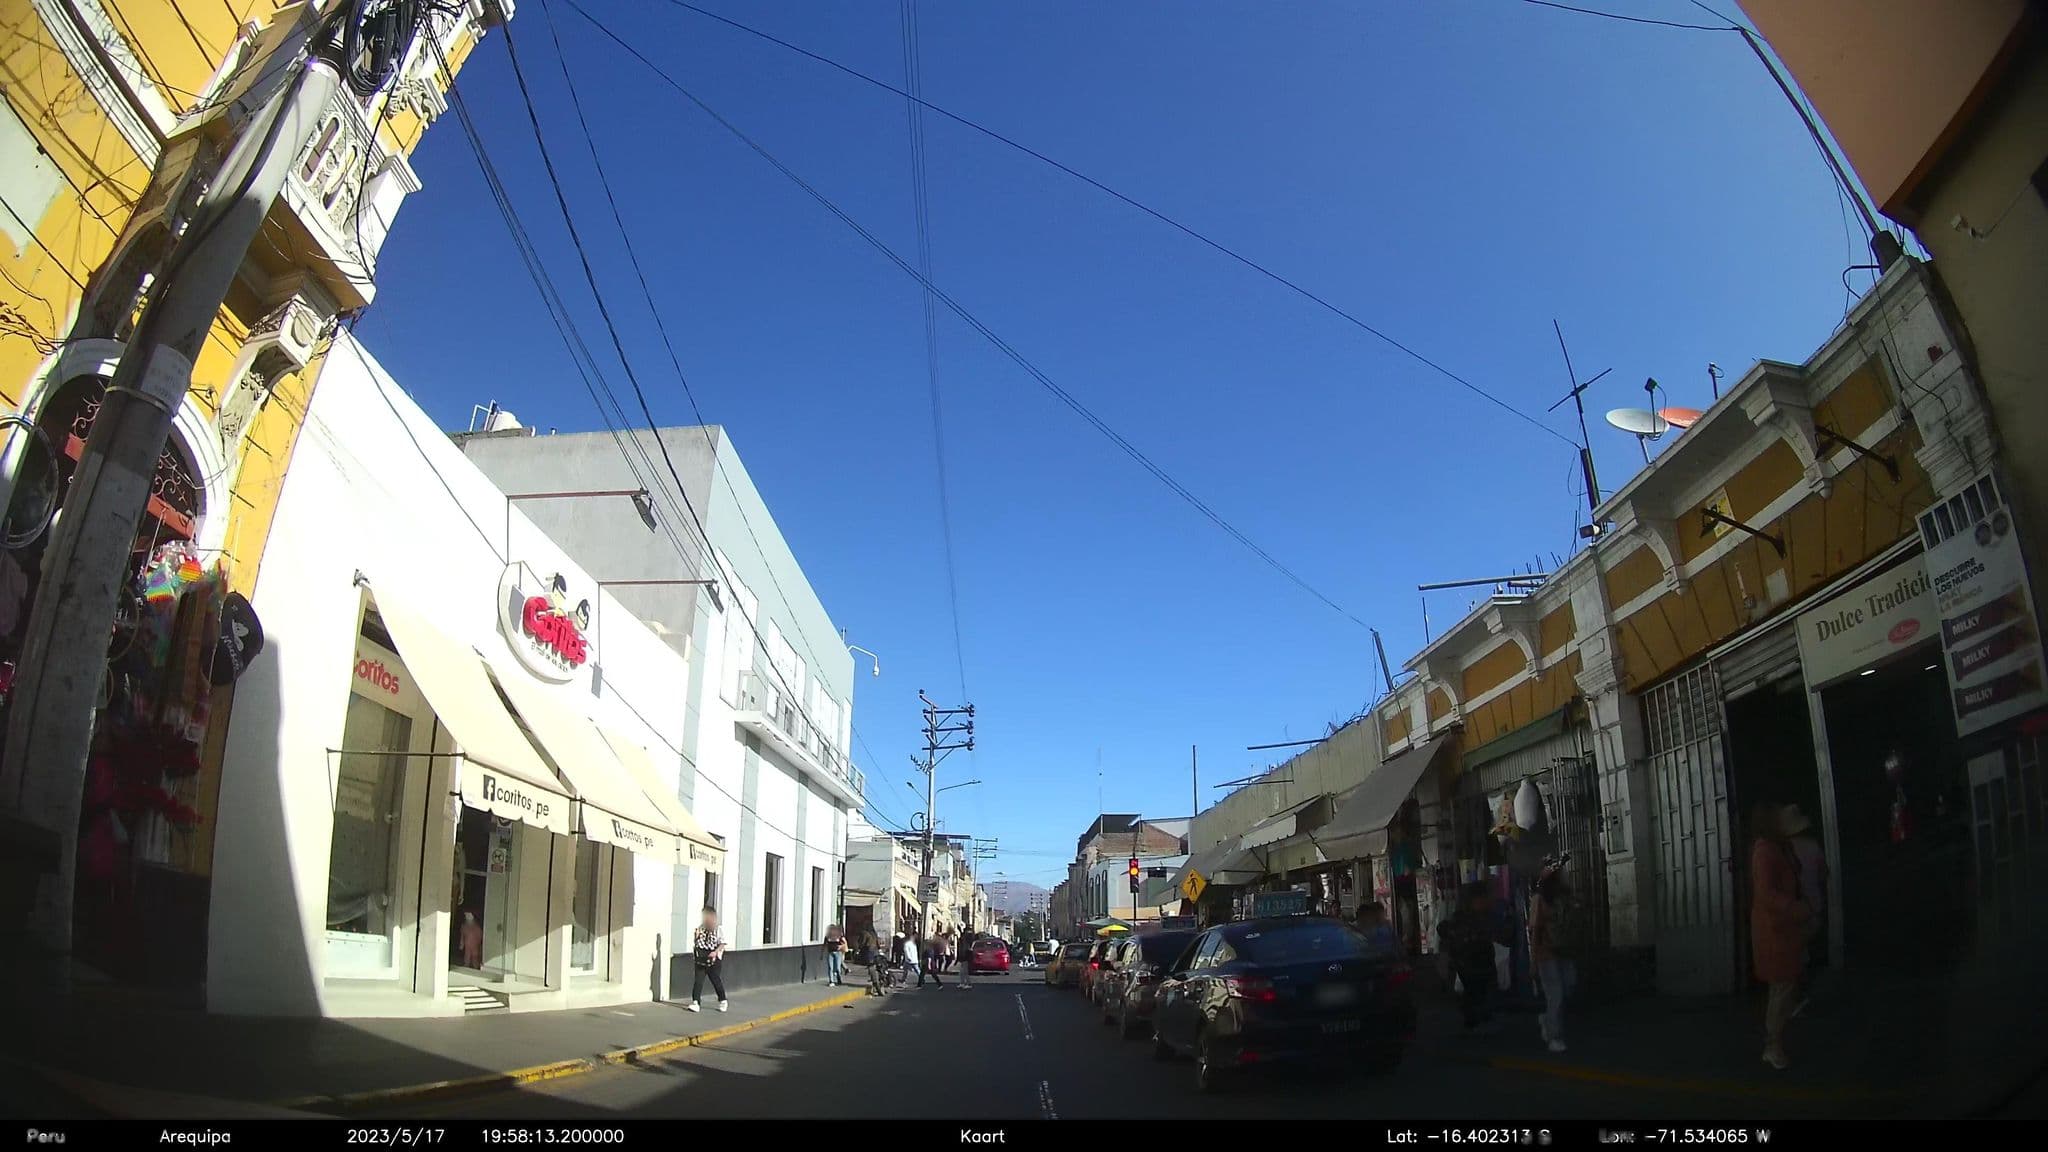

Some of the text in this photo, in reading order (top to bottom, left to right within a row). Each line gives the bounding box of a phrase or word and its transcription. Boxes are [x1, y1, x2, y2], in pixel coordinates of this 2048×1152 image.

[1934, 557, 1976, 586] DESCUBRE
[1936, 563, 1985, 595] LOS NUEVOS
[1815, 608, 1864, 642] Dulce
[1952, 614, 1981, 637] MILKY
[1961, 645, 1992, 668] MILKY
[355, 657, 400, 695] oritos
[1964, 688, 1993, 706] MILKY
